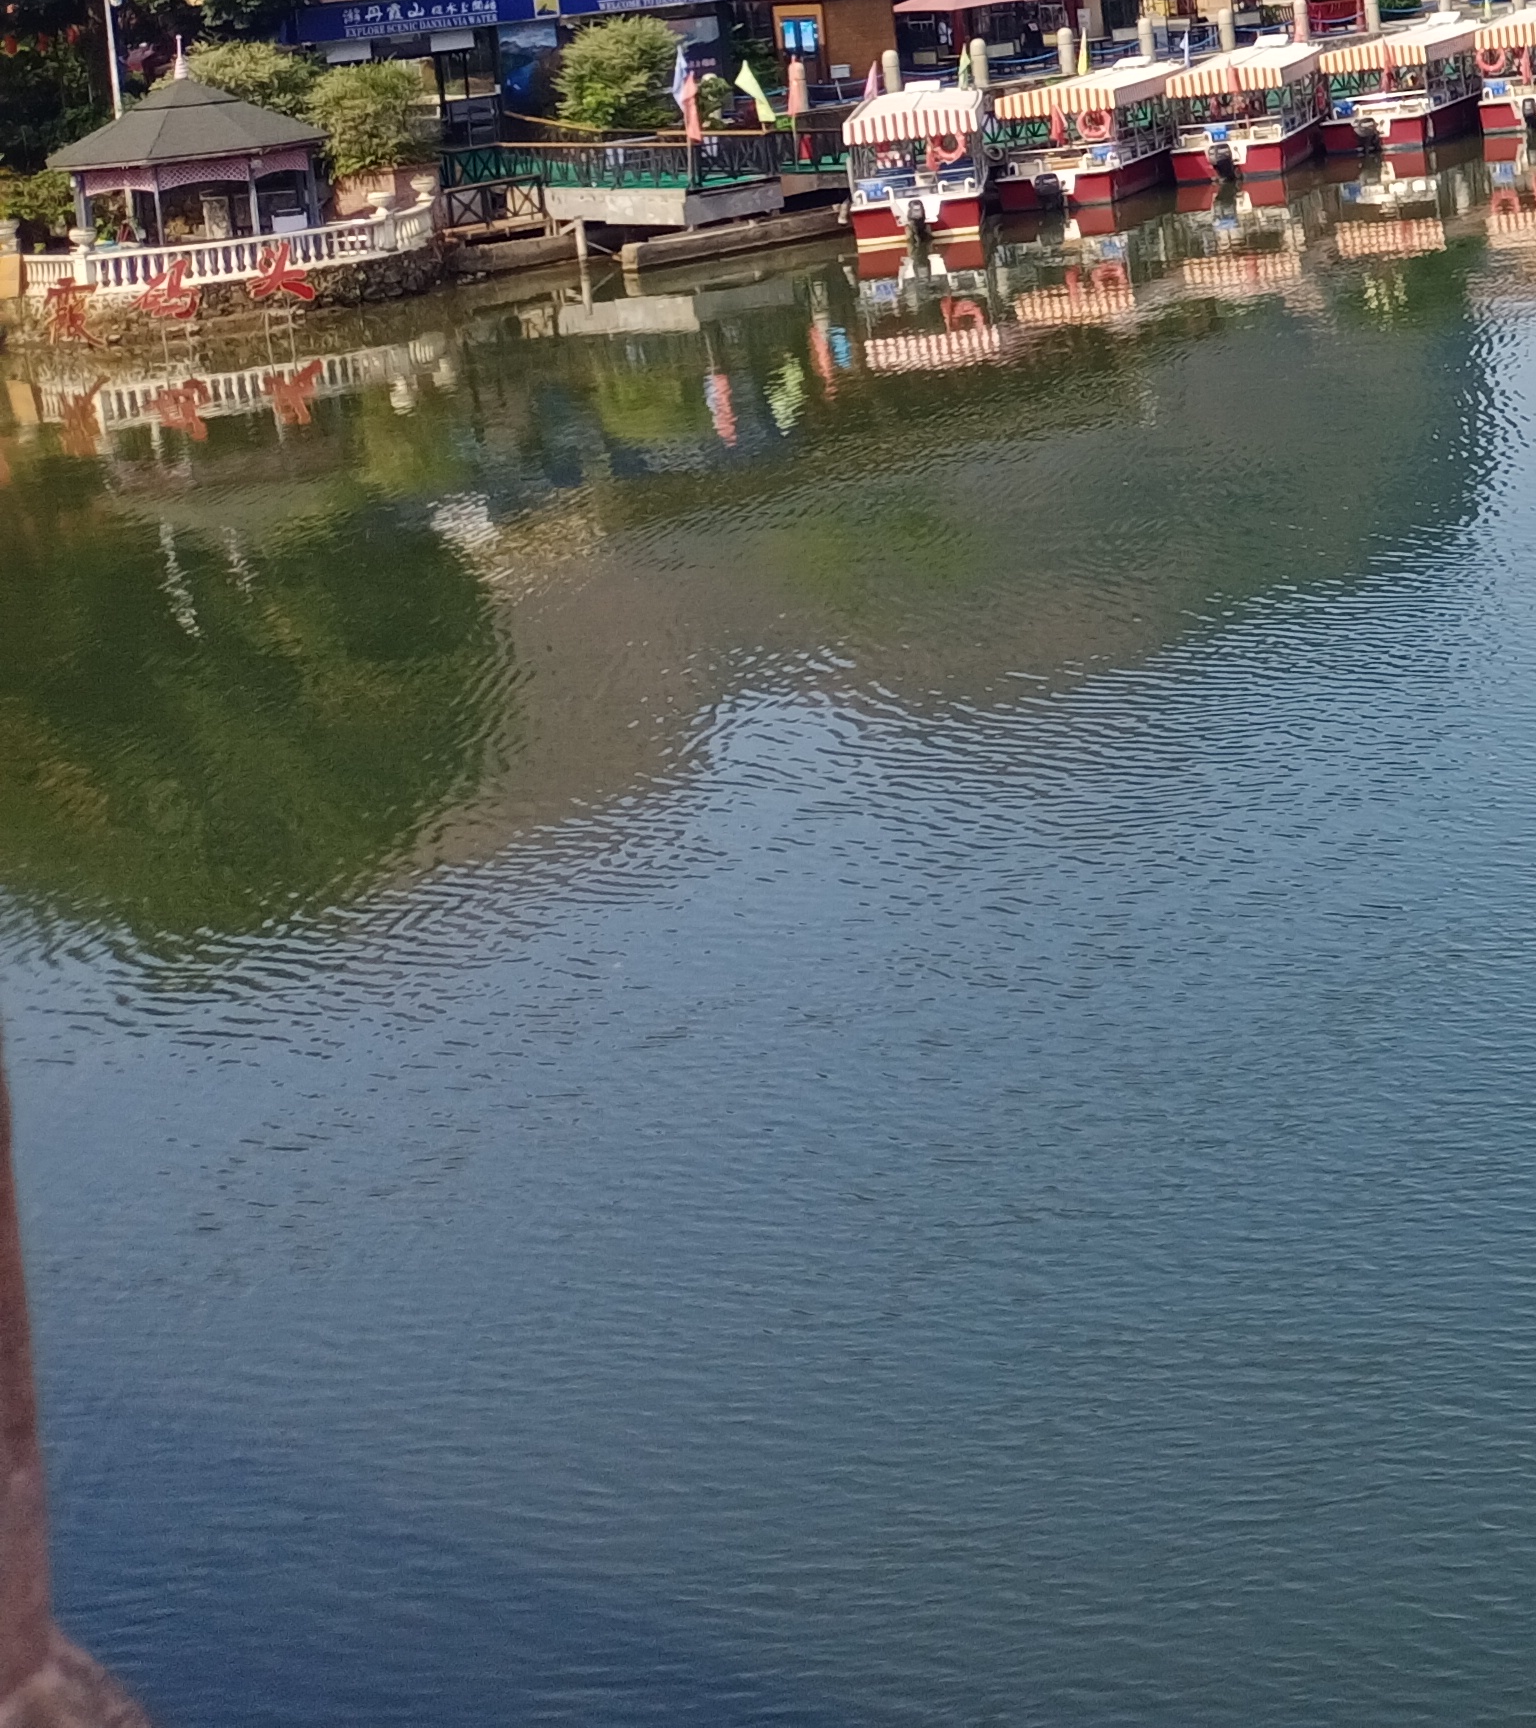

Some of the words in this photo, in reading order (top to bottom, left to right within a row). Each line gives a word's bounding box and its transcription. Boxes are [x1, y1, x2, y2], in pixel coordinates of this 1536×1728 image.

[599, 0, 642, 11] WELCOME
[345, 24, 386, 38] EXPLORE
[387, 20, 418, 34] SCENIC
[420, 17, 452, 30] DANXIA
[453, 15, 467, 27] VIA
[468, 12, 498, 24] WATER
